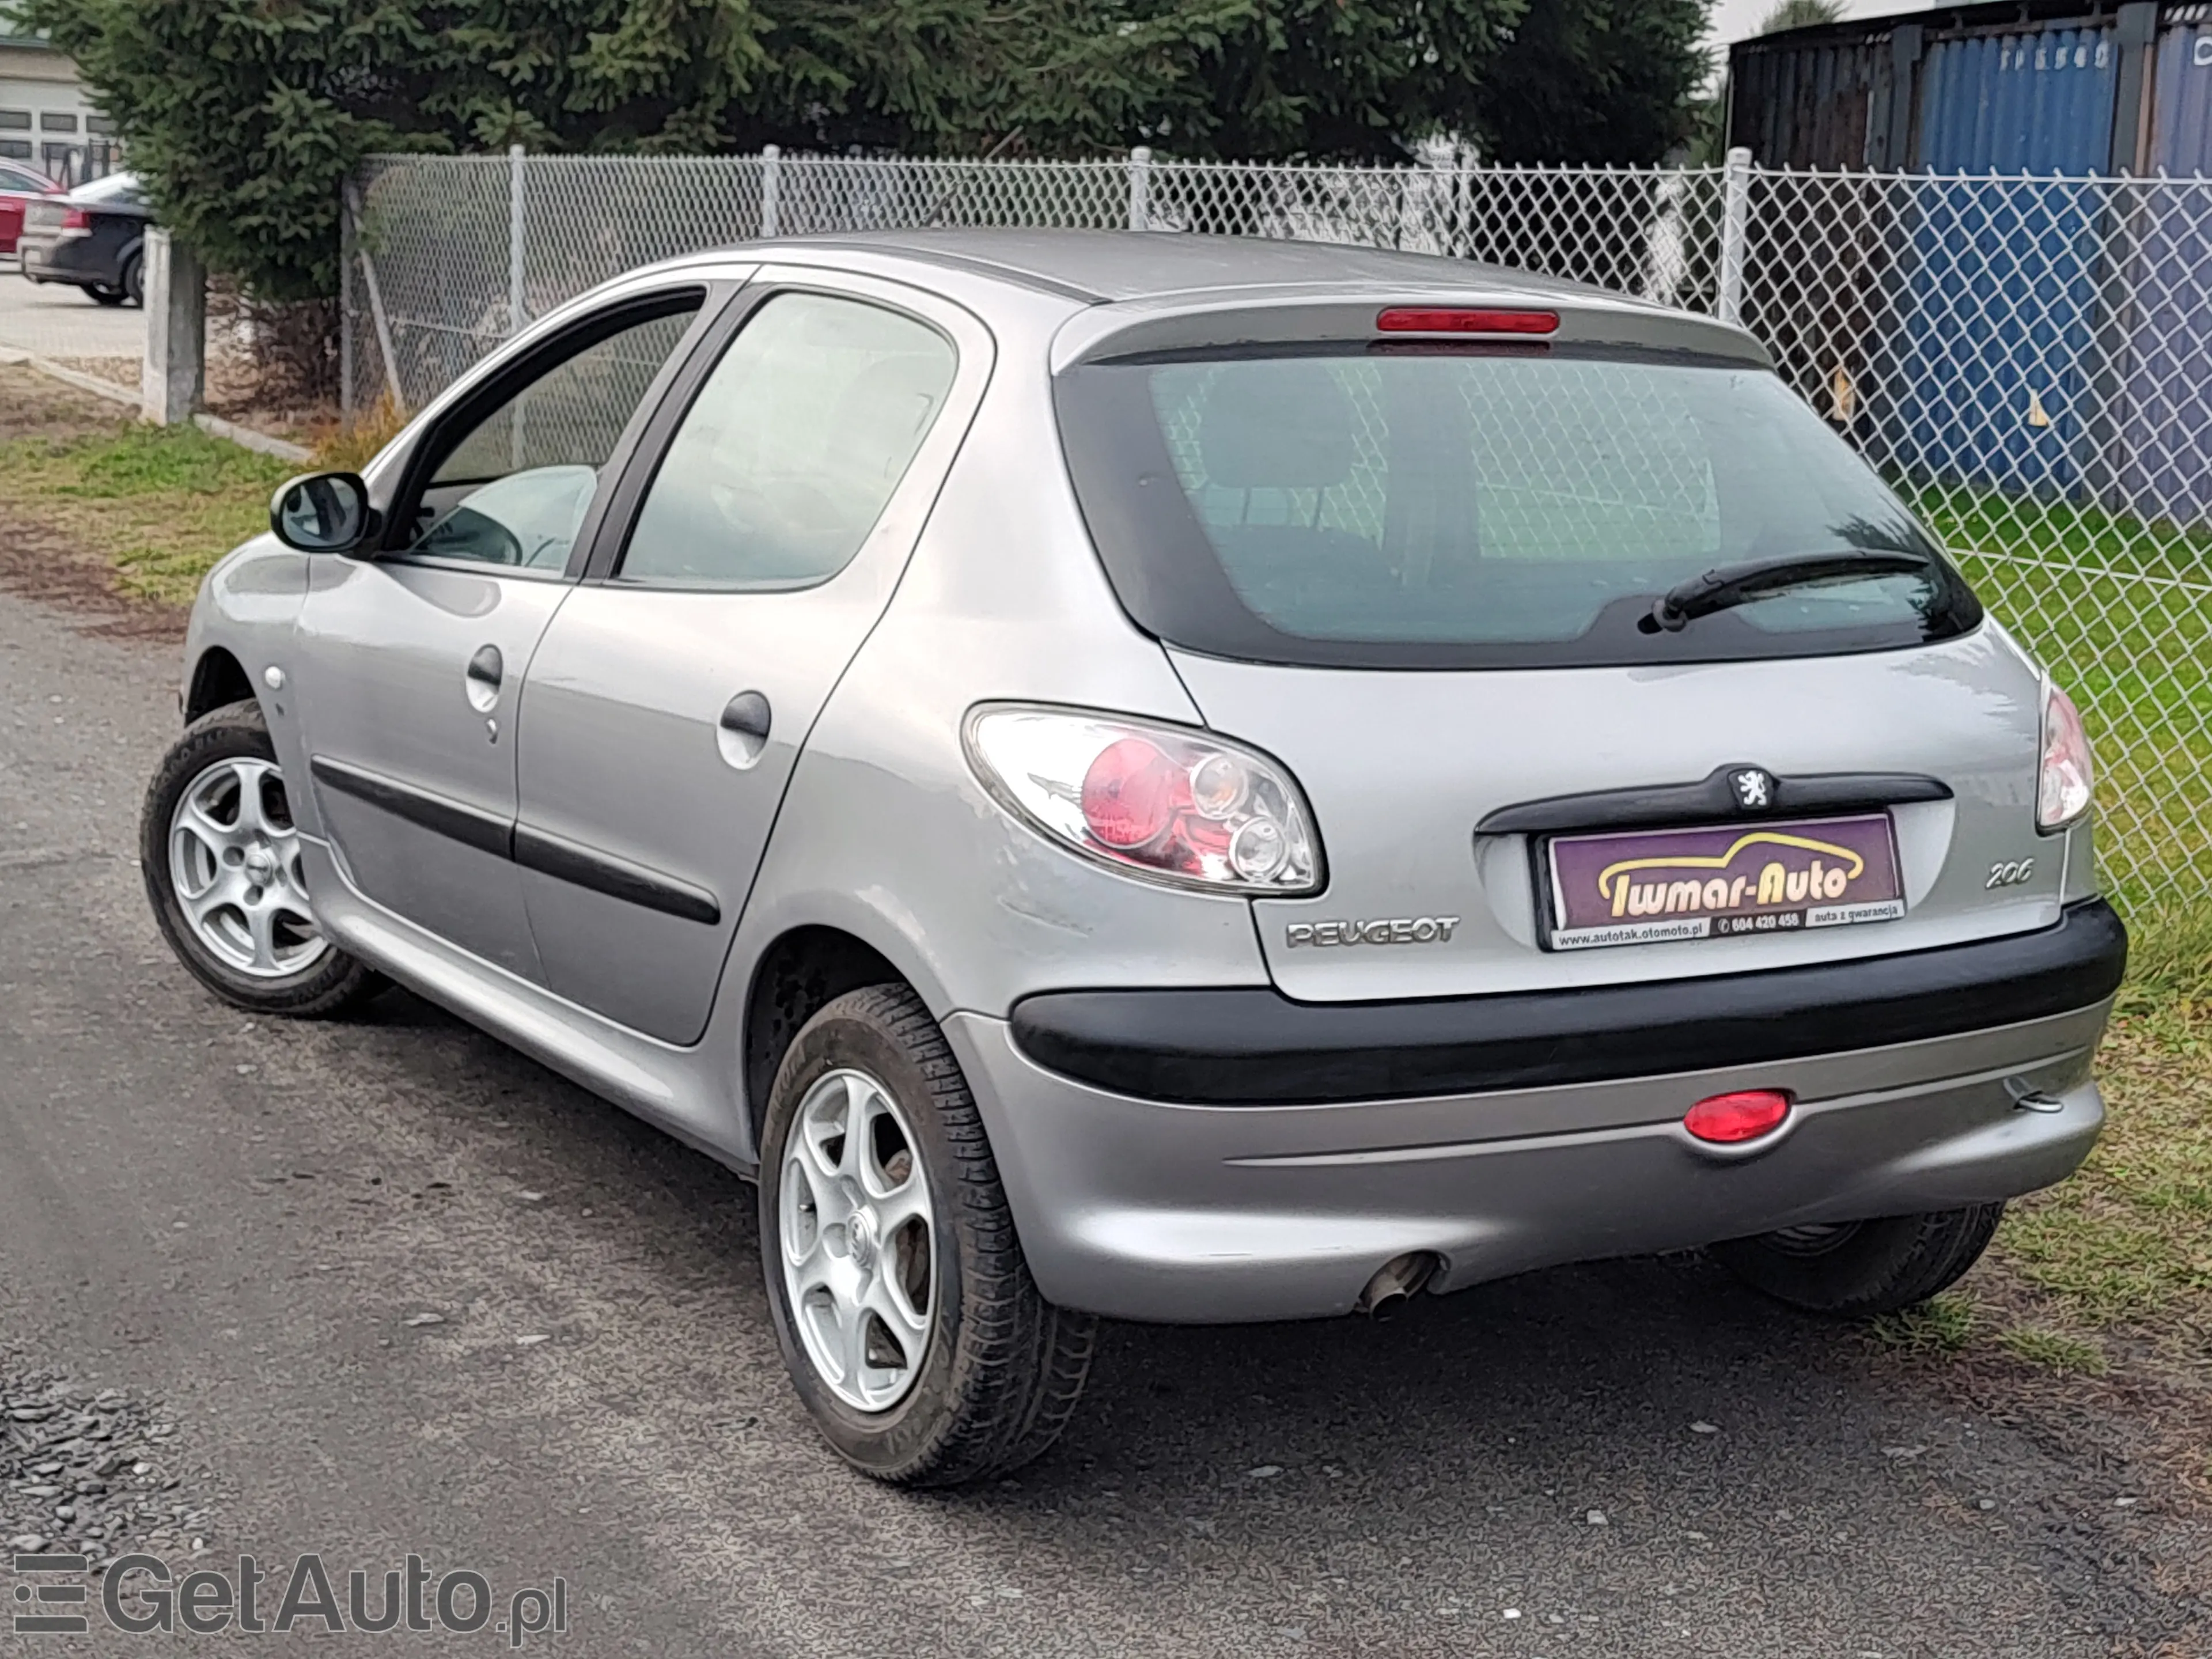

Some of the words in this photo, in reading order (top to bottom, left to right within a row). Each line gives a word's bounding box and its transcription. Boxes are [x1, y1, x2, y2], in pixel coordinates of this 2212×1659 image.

[1985, 857, 2035, 888] 206
[1755, 914, 1777, 929] 420
[1815, 910, 1837, 922] auta
[1286, 916, 1461, 949] PEUGEOT
[1558, 923, 1703, 946] www.autotak.otomoto.pl
